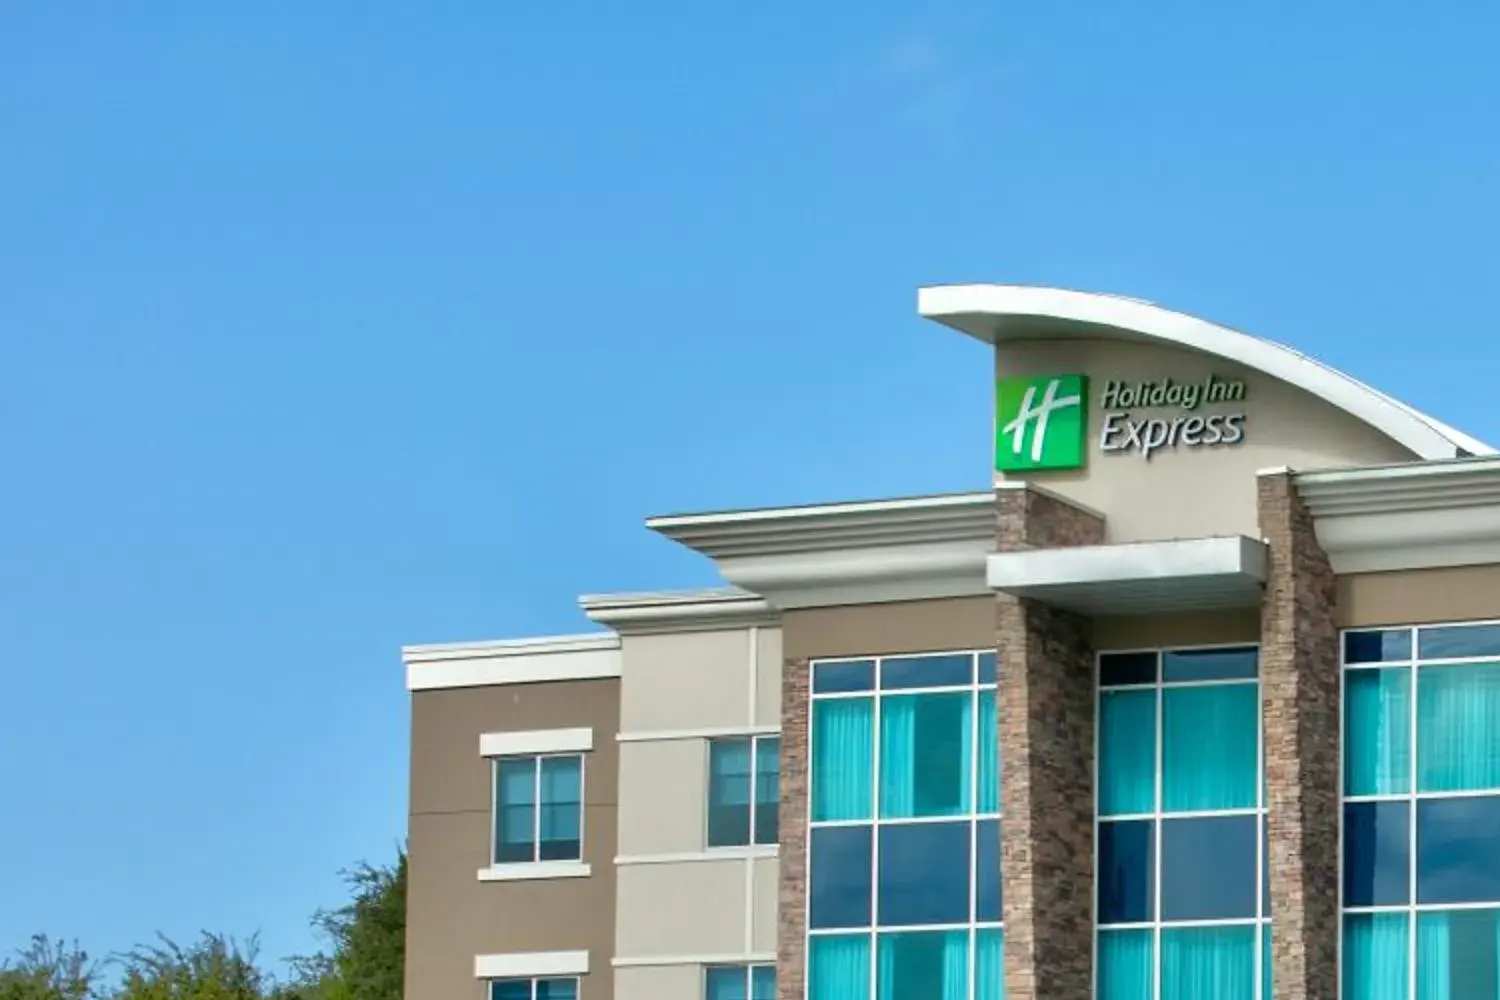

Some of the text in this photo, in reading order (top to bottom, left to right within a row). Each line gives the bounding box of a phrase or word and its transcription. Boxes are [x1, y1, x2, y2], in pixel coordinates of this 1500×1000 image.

[1100, 373, 1244, 409] Holiday Inn
[1100, 412, 1245, 460] Express
